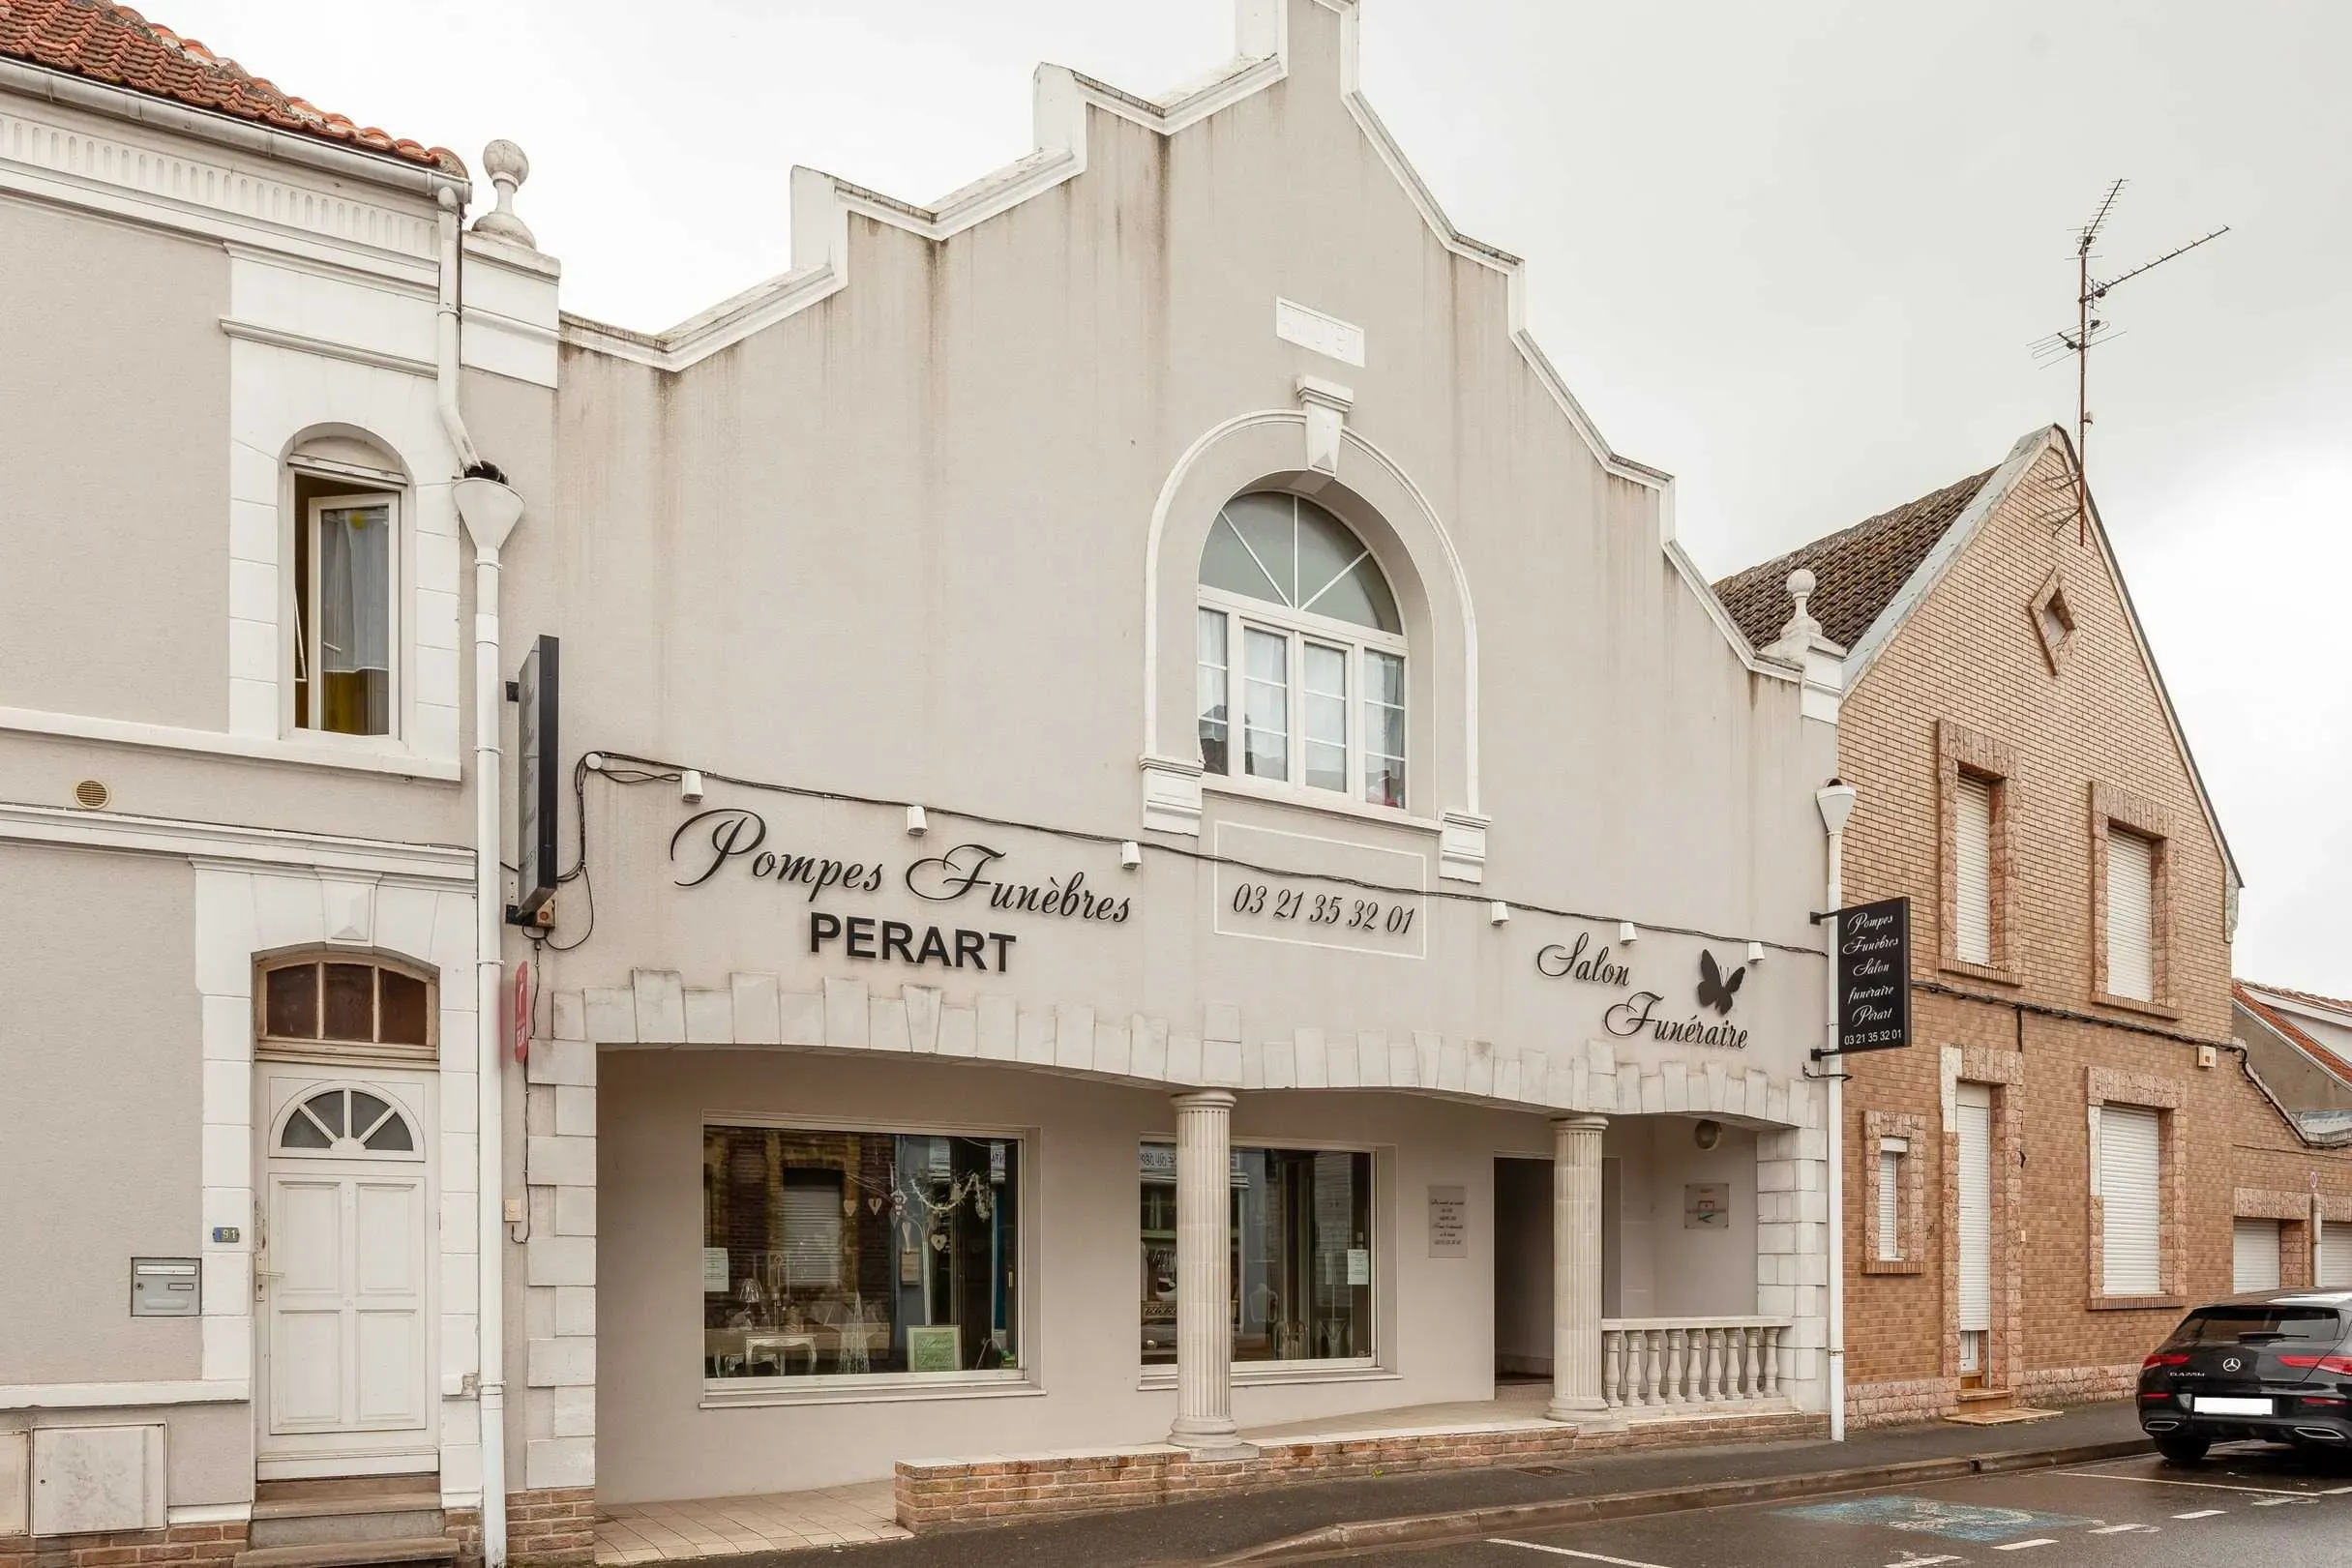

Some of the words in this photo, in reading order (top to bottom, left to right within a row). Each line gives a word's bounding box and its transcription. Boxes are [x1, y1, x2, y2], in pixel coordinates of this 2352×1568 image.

[670, 808, 882, 902] Pompes
[906, 843, 1130, 923] Funèbres
[1233, 882, 1267, 914] 03
[1272, 889, 1304, 919] 21
[1309, 894, 1343, 924] 35
[1348, 900, 1379, 930] 32
[1386, 905, 1415, 934] 01
[1847, 912, 1893, 935] Pompes
[811, 911, 1017, 973] PERART
[1842, 935, 1899, 956] Funèbres
[1537, 932, 1629, 987] Salon
[1853, 958, 1890, 977] Salon
[1848, 985, 1894, 1004] funéraire
[1604, 991, 1748, 1050] Funéraire
[1844, 1035, 1855, 1045] 03
[1856, 1034, 1865, 1044] 21
[1867, 1031, 1878, 1042] 35
[1880, 1029, 1891, 1041] 32
[1891, 1028, 1901, 1039] 01
[223, 1228, 235, 1239] 91
